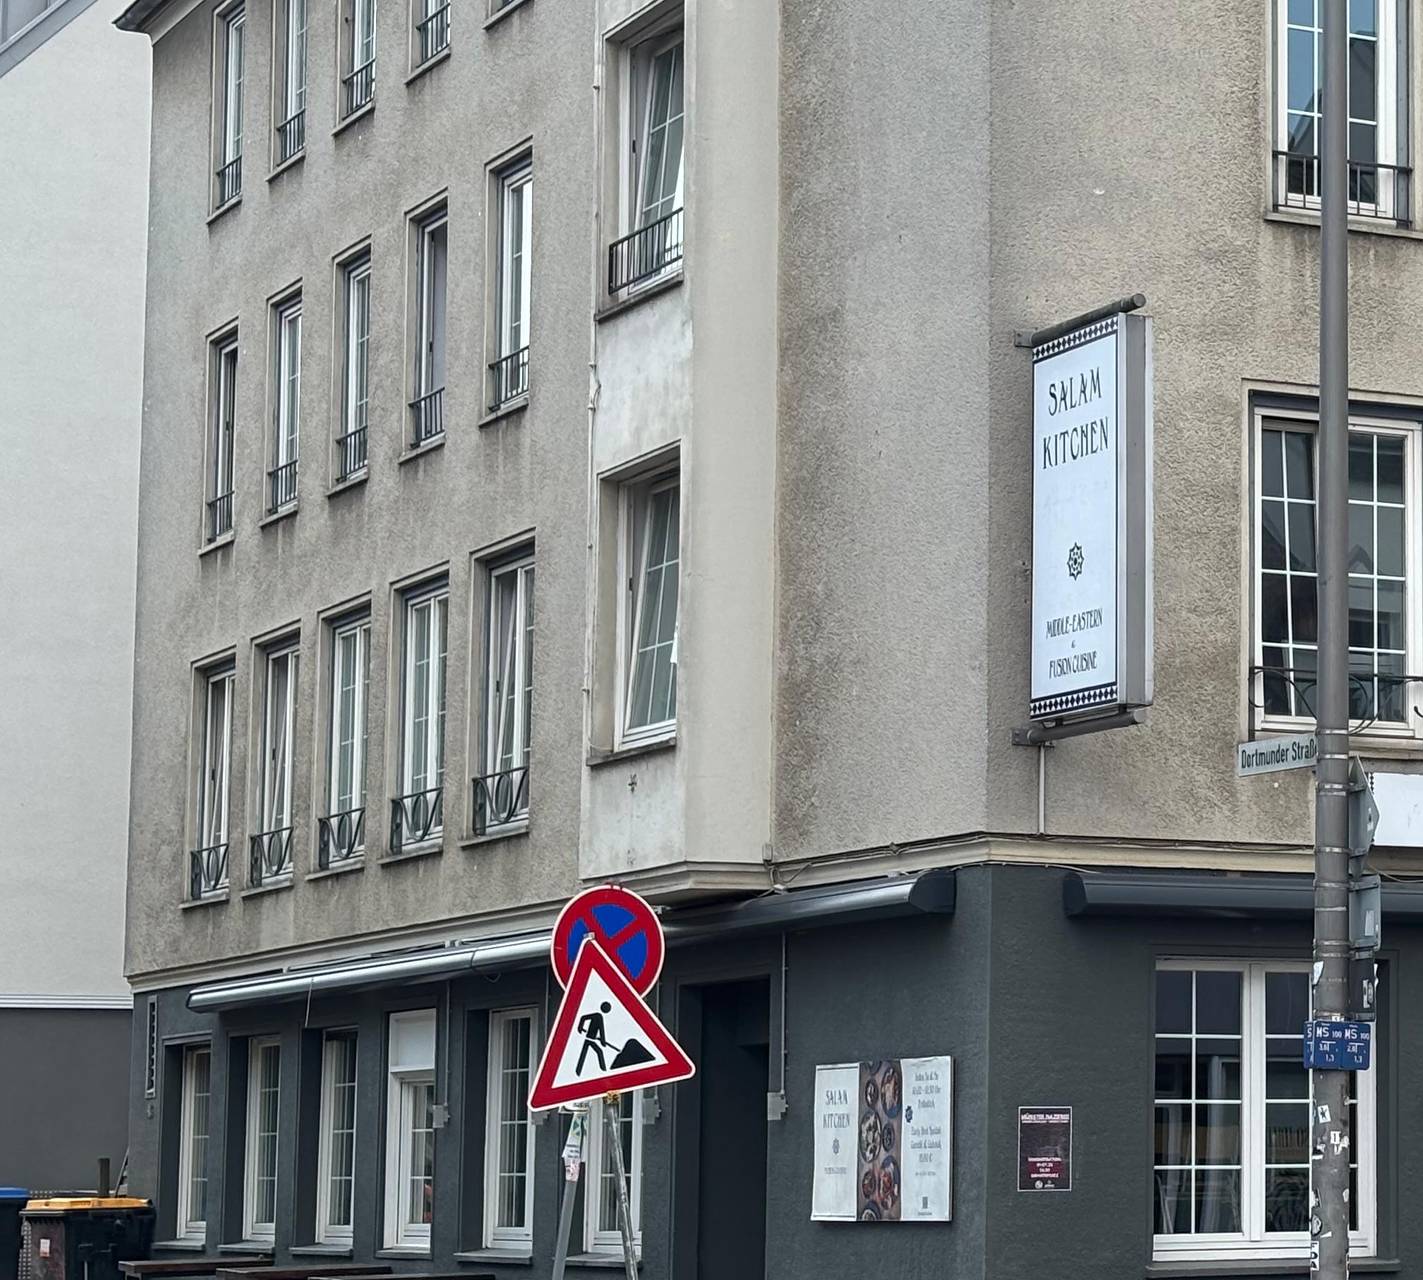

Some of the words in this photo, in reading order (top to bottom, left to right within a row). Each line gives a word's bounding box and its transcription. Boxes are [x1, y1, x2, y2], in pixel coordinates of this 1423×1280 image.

[1048, 367, 1101, 416] SALAM
[1043, 416, 1108, 469] KITCHEN
[1049, 657, 1071, 679] FUSION
[1073, 650, 1097, 673] CUISINE
[1241, 744, 1289, 768] Dortmunder
